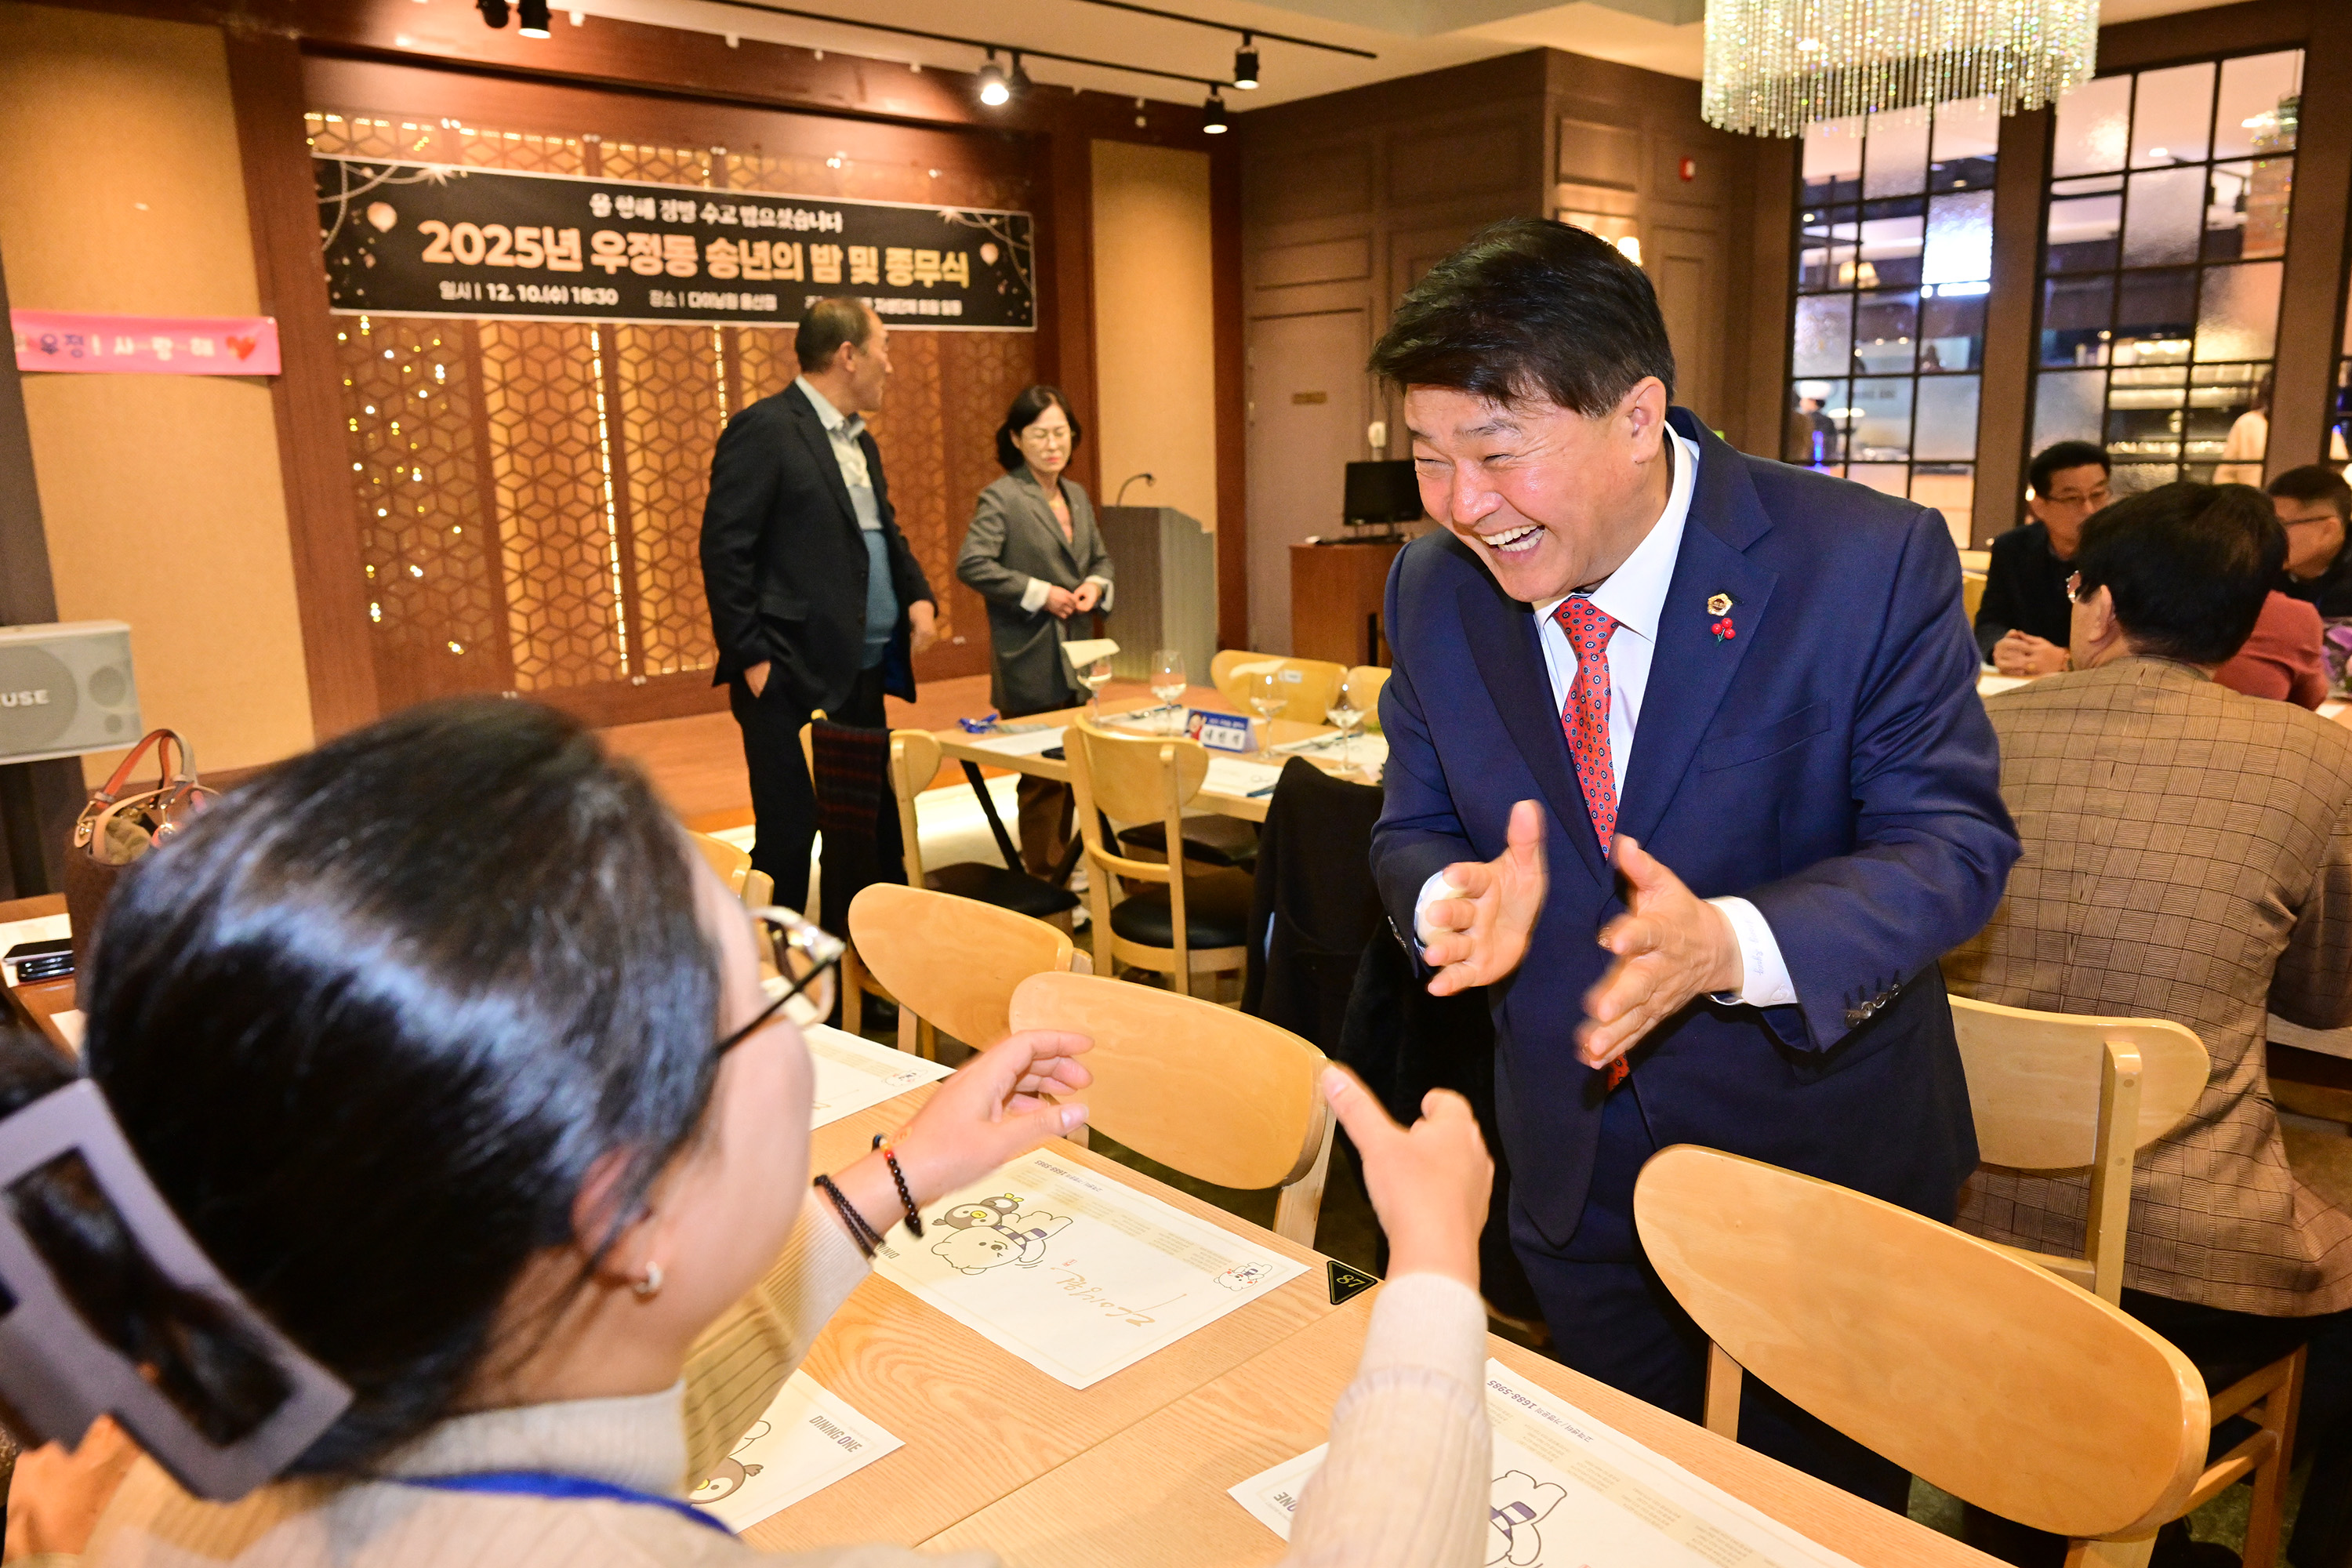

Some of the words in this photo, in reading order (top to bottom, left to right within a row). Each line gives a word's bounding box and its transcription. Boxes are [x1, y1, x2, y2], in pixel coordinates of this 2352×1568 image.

[659, 198, 697, 223] 정말
[699, 201, 739, 225] 수고
[417, 220, 583, 272] 2025년
[590, 230, 699, 278] 우정동
[706, 237, 804, 282] 송년의
[810, 243, 844, 284] 밤
[848, 245, 880, 285] 및
[885, 247, 970, 289] 종무식
[439, 281, 471, 301] 일시
[1336, 1274, 1367, 1288] 87
[1486, 1380, 1537, 1410] 1688-5985
[1534, 1407, 1563, 1425] 가맹문의
[809, 1415, 845, 1439] DINING
[837, 1436, 862, 1453] ONE
[1564, 1425, 1594, 1443] 고객센터
[1273, 1491, 1298, 1512] ONE
